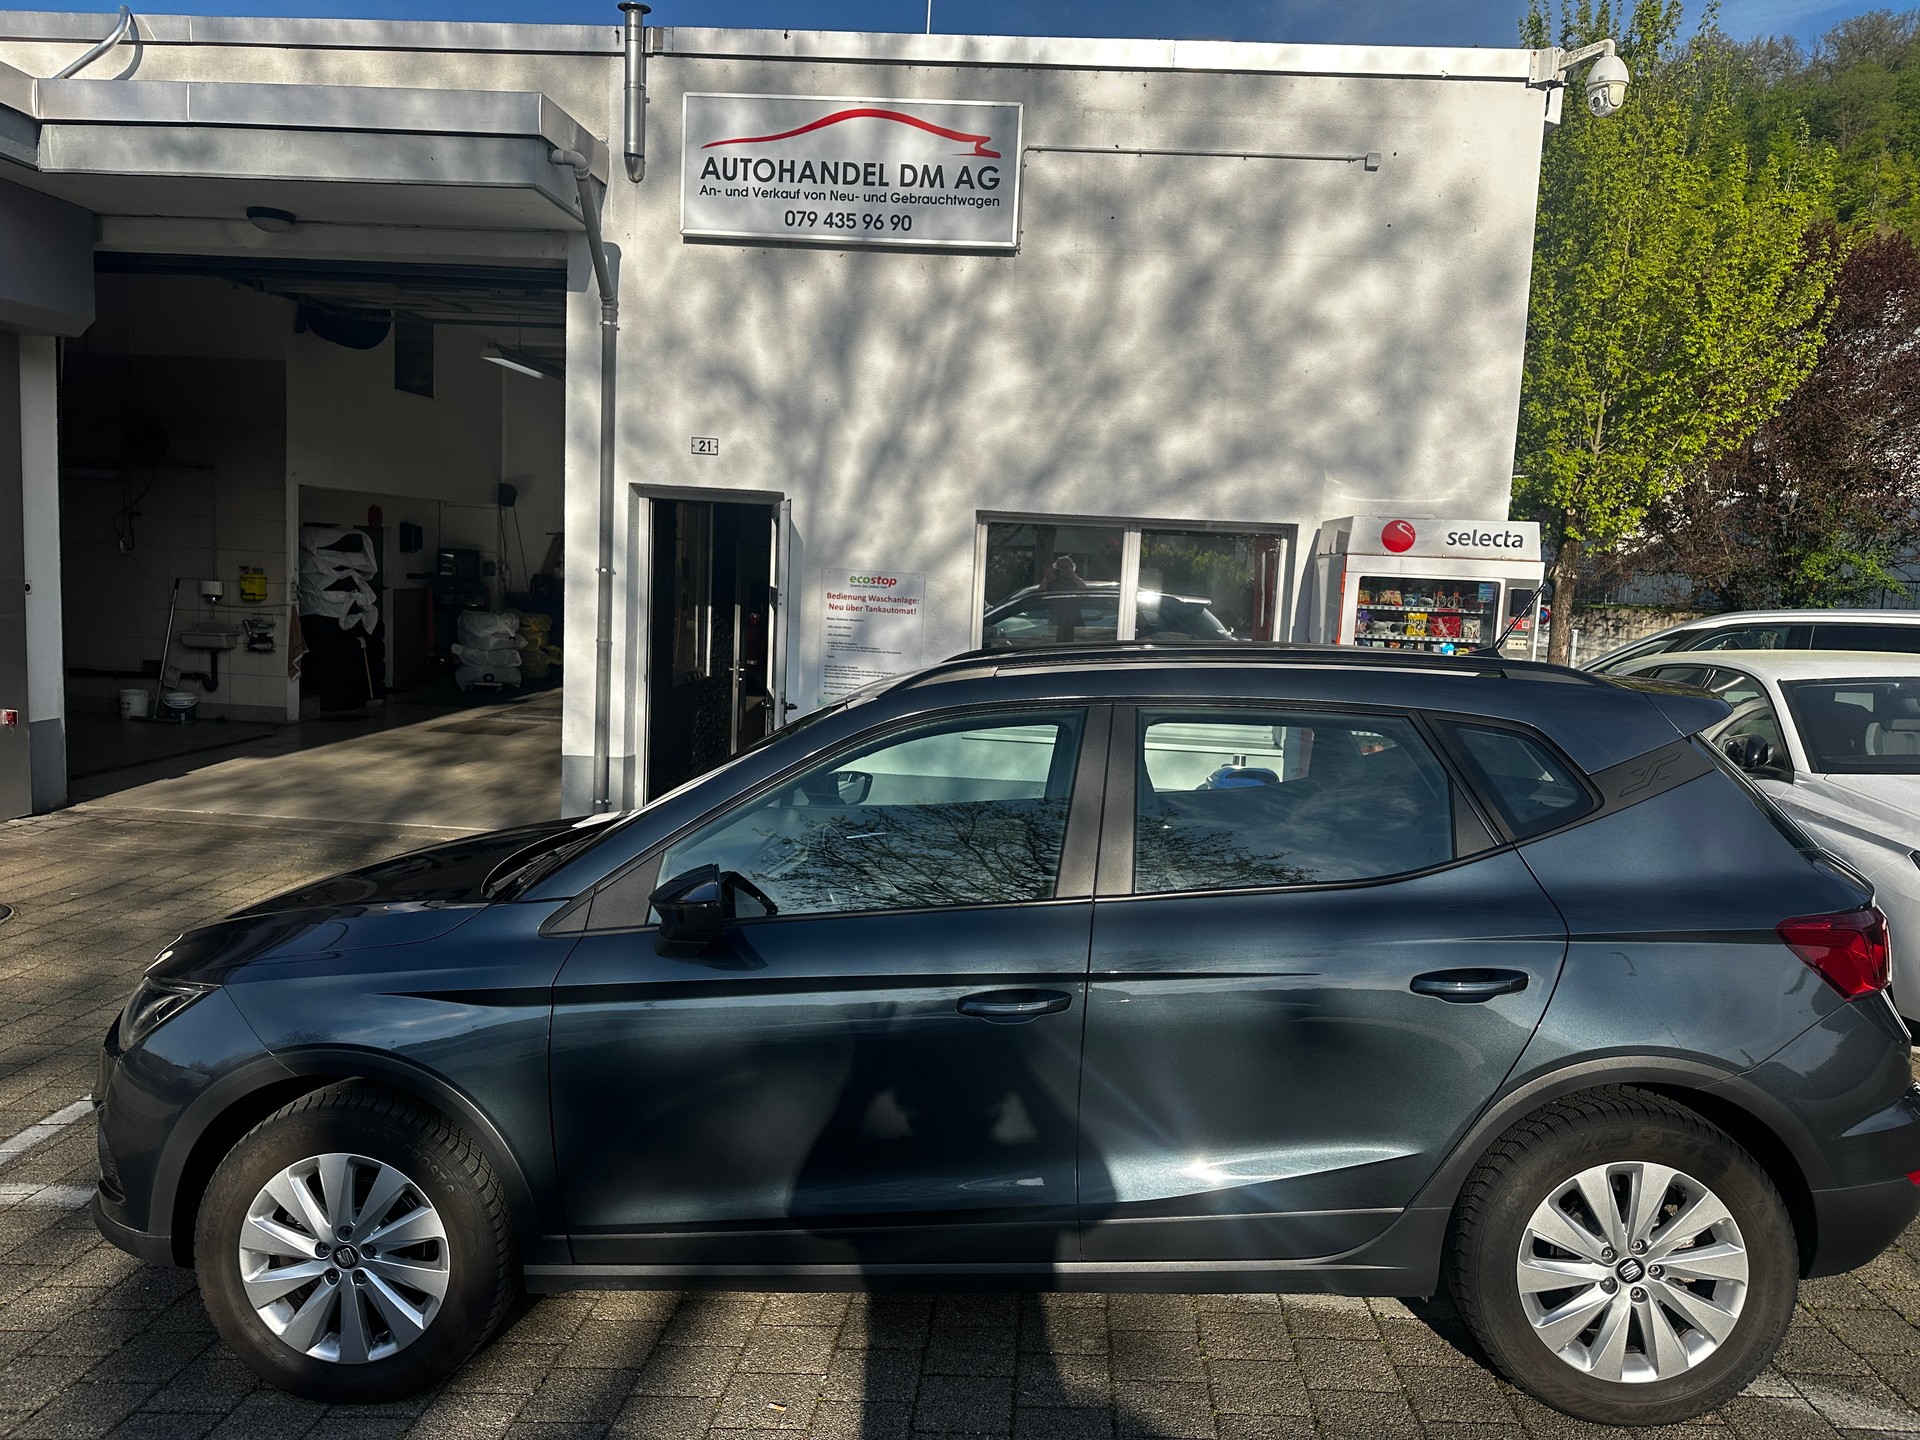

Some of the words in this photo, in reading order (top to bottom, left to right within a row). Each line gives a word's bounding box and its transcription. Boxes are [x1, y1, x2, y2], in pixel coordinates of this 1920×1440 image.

[700, 156, 890, 188] AUTOHANDEL
[899, 163, 945, 188] DM
[954, 165, 1001, 190] AG
[699, 184, 722, 196] An-
[725, 187, 749, 198] und
[752, 187, 801, 200] Verkauf
[803, 191, 826, 201] von
[829, 190, 860, 202] Neu-
[863, 192, 887, 203] und
[890, 192, 1000, 209] Gebrauchtwagen
[784, 210, 818, 228] 079
[823, 212, 857, 229] 435
[862, 213, 885, 231] 96
[890, 214, 913, 232] 90
[699, 440, 711, 452] 21
[1445, 529, 1524, 549] selecta
[849, 575, 897, 588] ecostop
[826, 592, 867, 603] Bedienung
[868, 595, 920, 606] Waschanlage:
[828, 603, 844, 611] Neu
[845, 603, 863, 612] über
[865, 605, 917, 615] Tankautomat!
